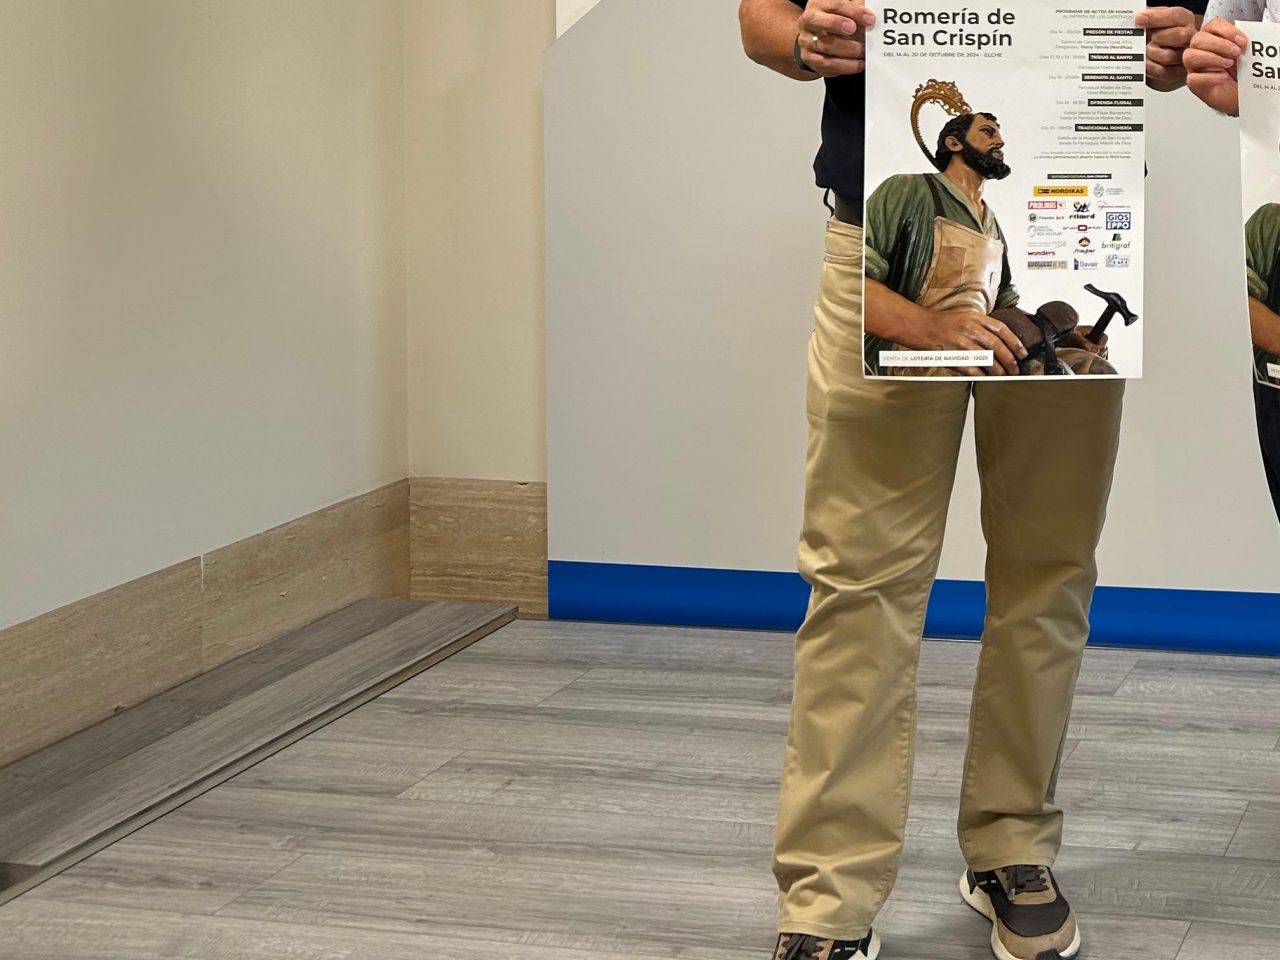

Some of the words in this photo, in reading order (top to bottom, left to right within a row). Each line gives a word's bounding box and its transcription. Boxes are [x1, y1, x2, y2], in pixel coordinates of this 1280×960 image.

[883, 7, 980, 24] Romería
[987, 8, 1015, 24] de
[883, 29, 925, 46] San
[933, 28, 1012, 50] Crispín
